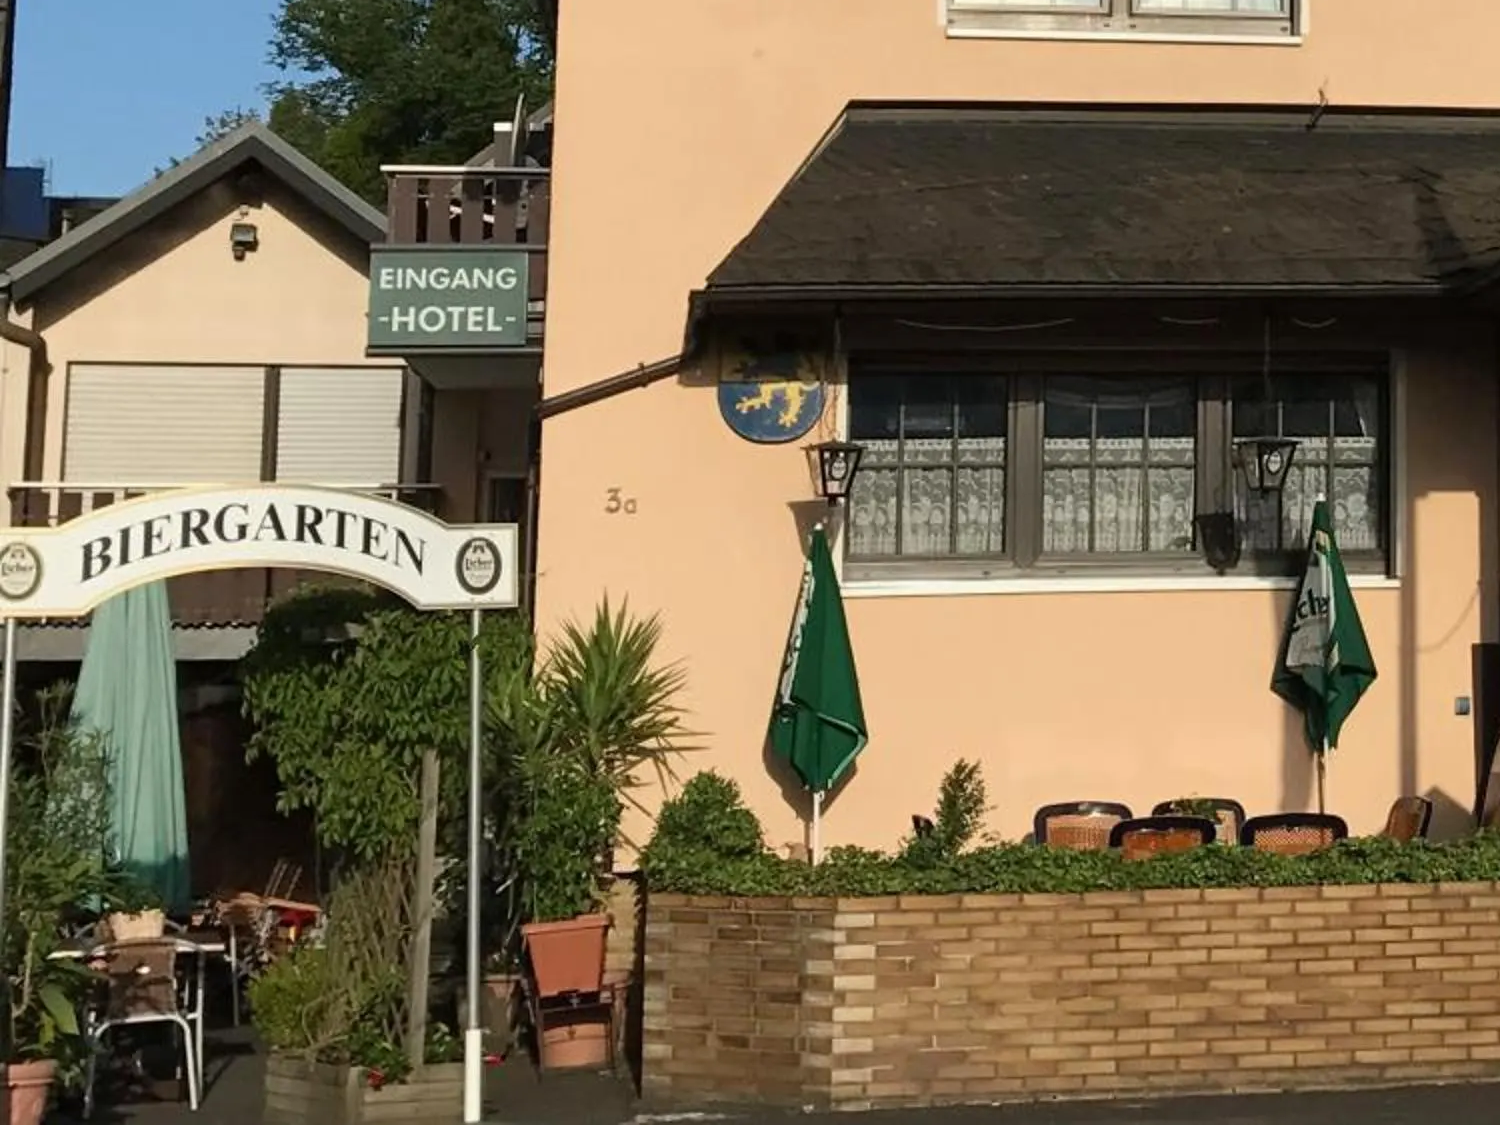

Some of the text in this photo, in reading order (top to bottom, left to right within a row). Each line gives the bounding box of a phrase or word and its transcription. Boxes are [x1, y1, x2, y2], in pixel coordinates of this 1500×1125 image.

[379, 267, 518, 291] EINGANG
[604, 487, 638, 515] 3a
[80, 502, 427, 584] BIERGARTEN
